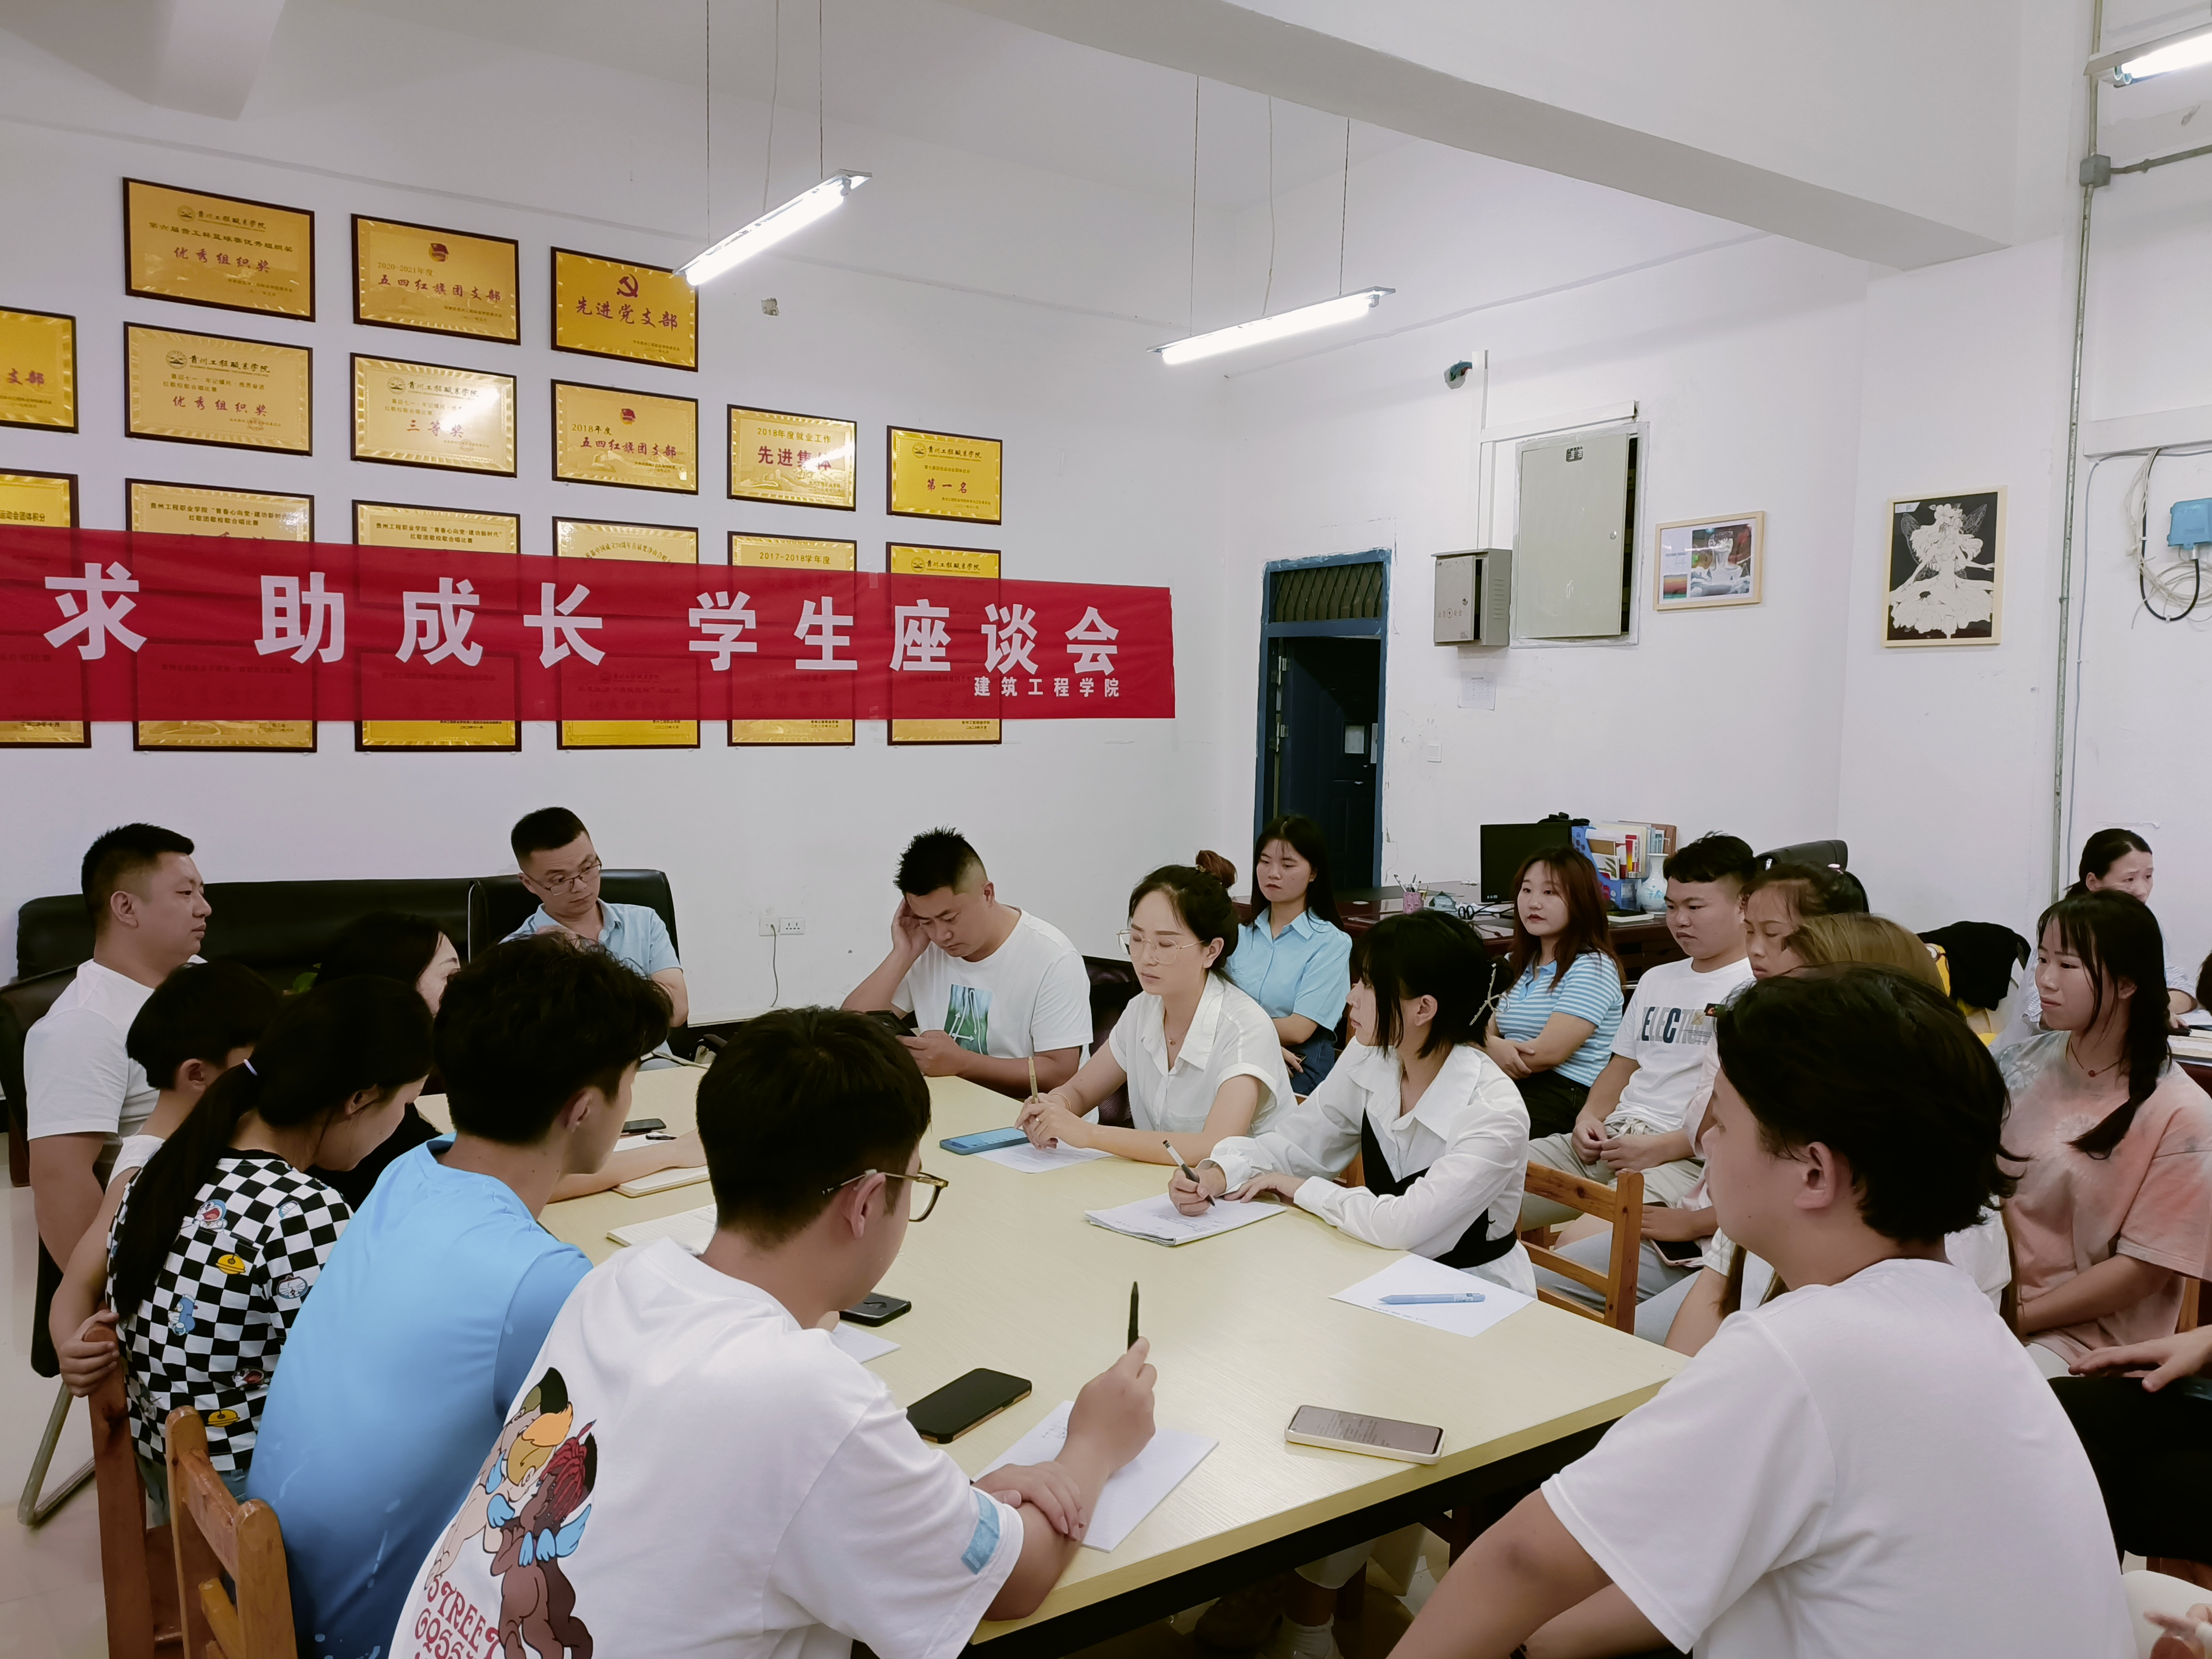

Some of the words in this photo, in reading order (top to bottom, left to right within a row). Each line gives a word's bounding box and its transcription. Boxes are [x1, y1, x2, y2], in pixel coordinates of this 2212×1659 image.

[174, 246, 270, 273] 优秀组织奖
[378, 274, 501, 303] 五四红旗团支部
[575, 296, 678, 332] 先进党支部
[173, 396, 267, 417] 优秀组织奖
[407, 419, 464, 438] 三等奖
[571, 423, 612, 436] 2018年度
[757, 428, 831, 444] 2018年度就业工作
[580, 436, 676, 459] 五四红旗团支部
[927, 477, 968, 494] 第一名
[760, 552, 831, 565] 2017-2018学年度
[44, 561, 147, 660] 求
[254, 571, 606, 669] 助成长
[687, 590, 1120, 676] 学生座谈会
[973, 676, 1120, 698] 建筑工程学院
